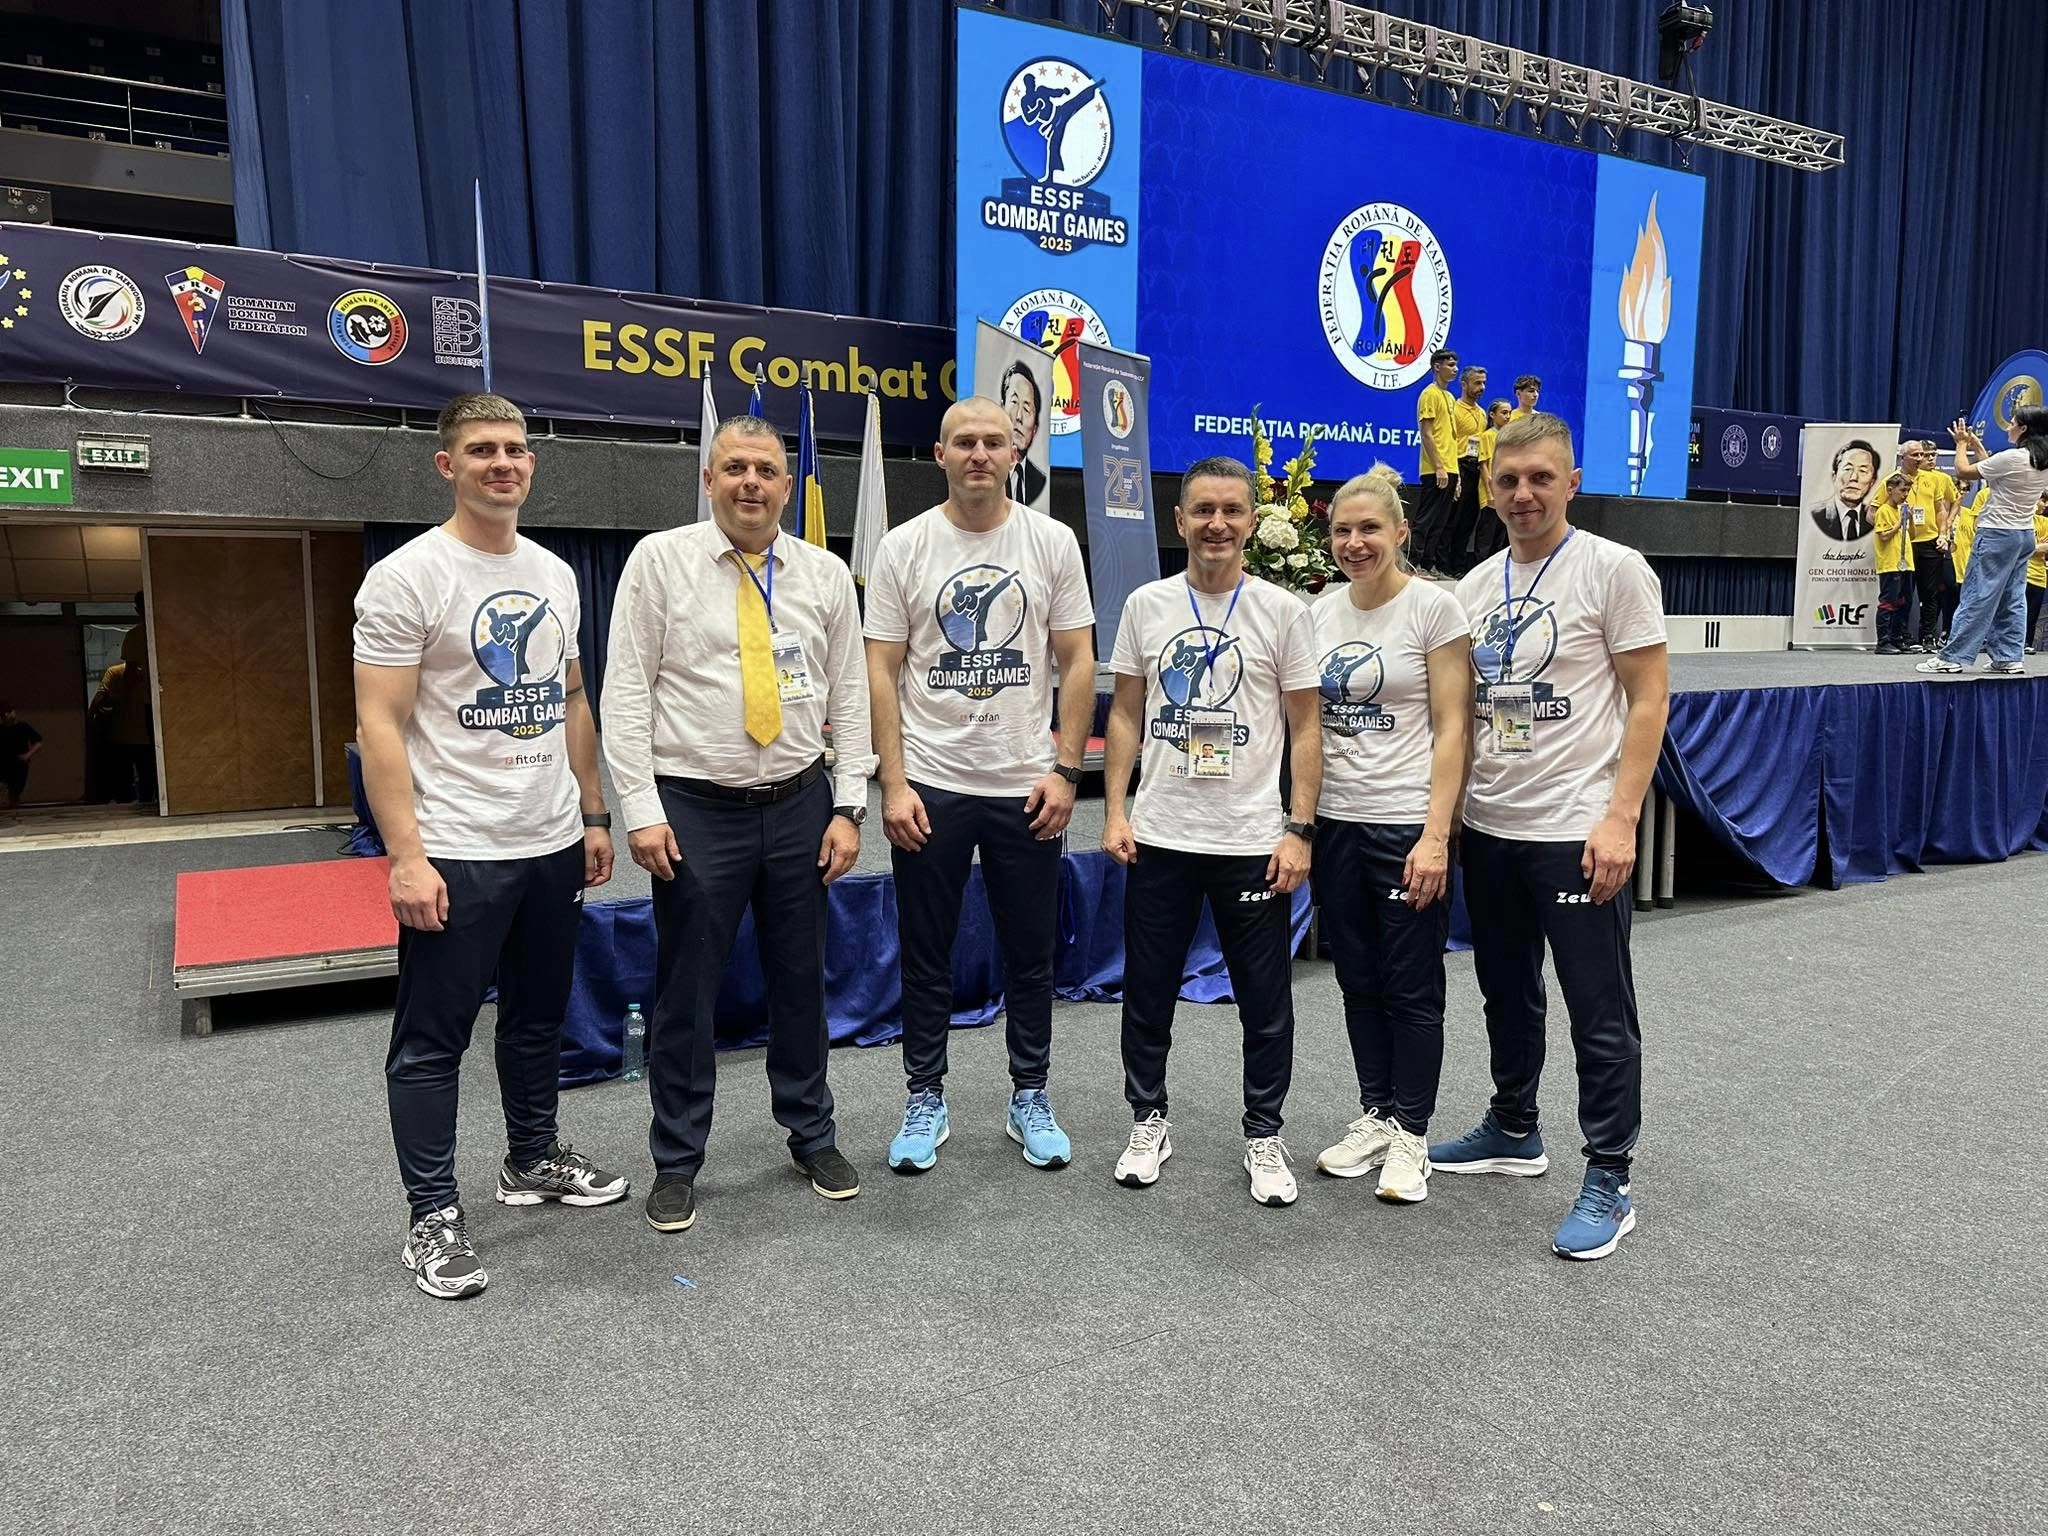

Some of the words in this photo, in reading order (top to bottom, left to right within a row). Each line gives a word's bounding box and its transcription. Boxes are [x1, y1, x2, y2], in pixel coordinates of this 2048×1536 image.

[1030, 185, 1084, 211] ESSF
[984, 200, 1060, 234] COMBAT
[1064, 212, 1126, 244] GAMES
[1405, 216, 1423, 237] DE
[1039, 235, 1073, 252] 2025
[102, 267, 113, 276] DE
[115, 272, 143, 312] TAEKWONDO
[228, 296, 296, 312] ROMANIAN
[1069, 299, 1086, 315] DE
[228, 308, 276, 322] BOXING
[229, 320, 307, 336] FEDERATION
[1357, 339, 1417, 357] ROMÂNIA
[582, 319, 716, 379] ESSF
[728, 335, 928, 400] Combat
[1378, 428, 1400, 445] DE
[91, 449, 135, 462] EXIT
[0, 466, 64, 490] EXIT
[1826, 568, 1846, 576] CHOI
[1847, 568, 1870, 576] HONG
[1870, 568, 1877, 576] H
[960, 652, 1002, 668] ESSF
[928, 669, 984, 687] COMBAT
[986, 666, 1030, 686] GAMES
[503, 686, 550, 705] ESSF
[967, 686, 993, 697] 2025
[461, 705, 529, 727] COMBAT
[1331, 704, 1365, 714] ESSF
[1533, 699, 1568, 718] MES
[512, 724, 543, 736] 2025
[1348, 715, 1392, 729] GAMES
[515, 752, 553, 766] fitofan
[1556, 891, 1591, 904] Zeu
